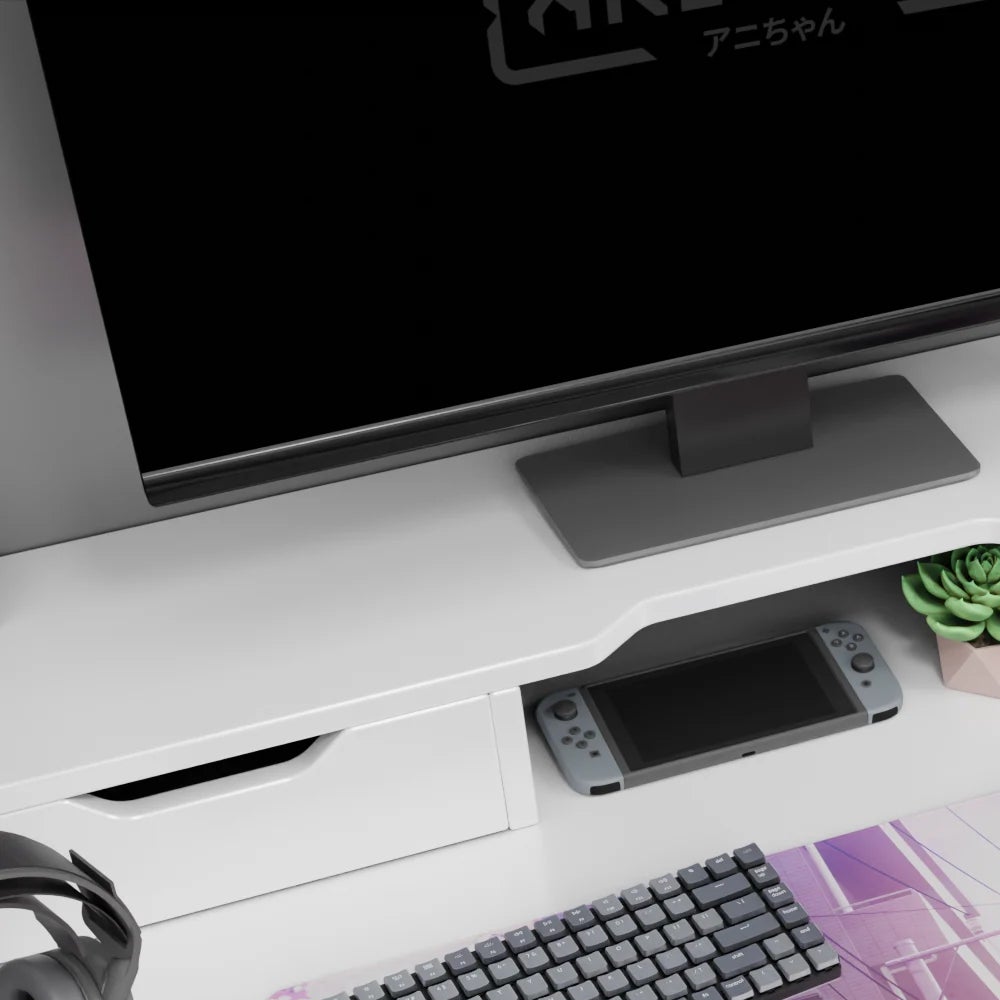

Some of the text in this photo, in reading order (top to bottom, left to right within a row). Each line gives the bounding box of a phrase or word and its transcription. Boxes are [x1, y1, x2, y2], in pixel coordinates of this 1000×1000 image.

[703, 7, 846, 57] アニちゃん
